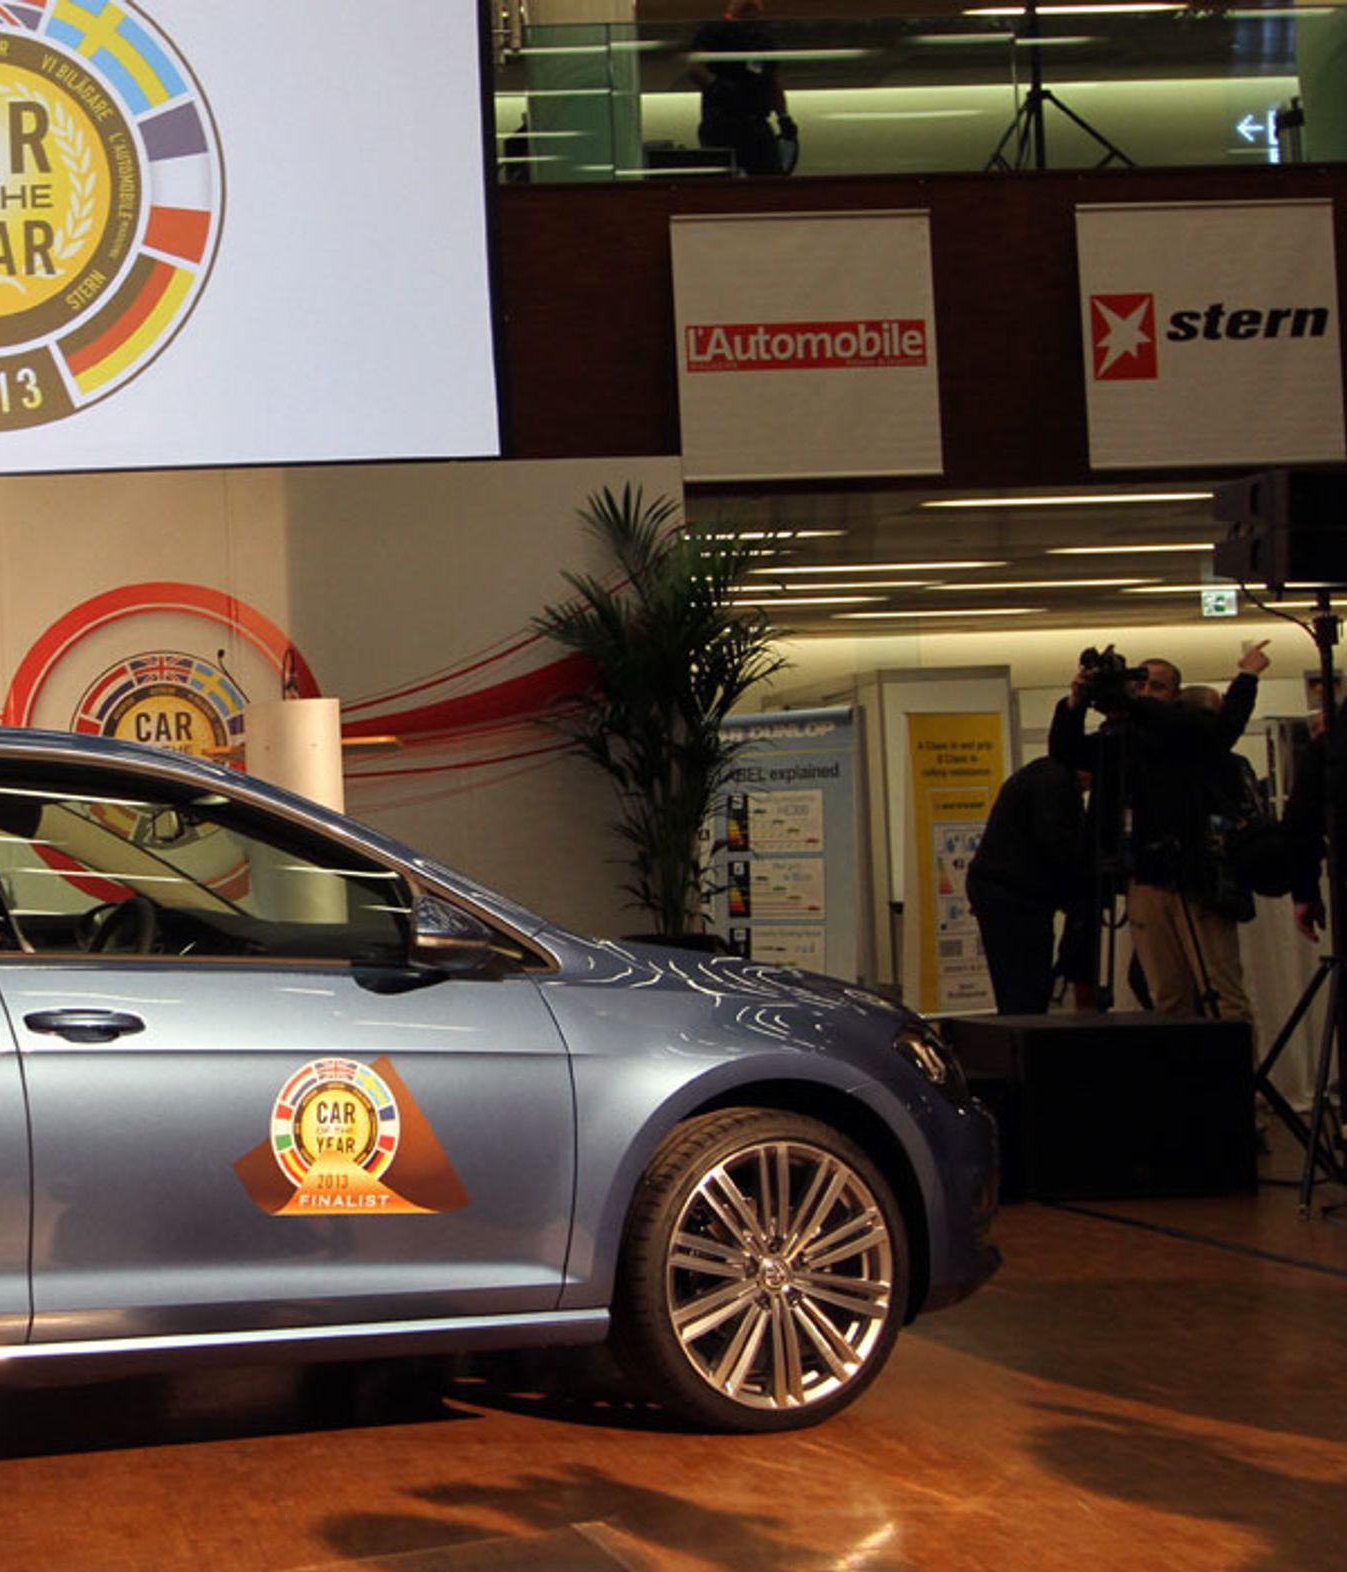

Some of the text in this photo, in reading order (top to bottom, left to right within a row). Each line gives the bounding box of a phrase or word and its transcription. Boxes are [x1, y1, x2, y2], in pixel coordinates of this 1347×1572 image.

[65, 269, 107, 310] STERN
[1167, 303, 1329, 342] stern
[688, 322, 924, 362] L'Automobile
[135, 711, 193, 742] CAR
[770, 761, 839, 784] explained
[316, 1101, 356, 1124] CAR
[316, 1136, 356, 1153] YEAR
[317, 1174, 349, 1190] 2013
[299, 1194, 391, 1208] FINALIST
